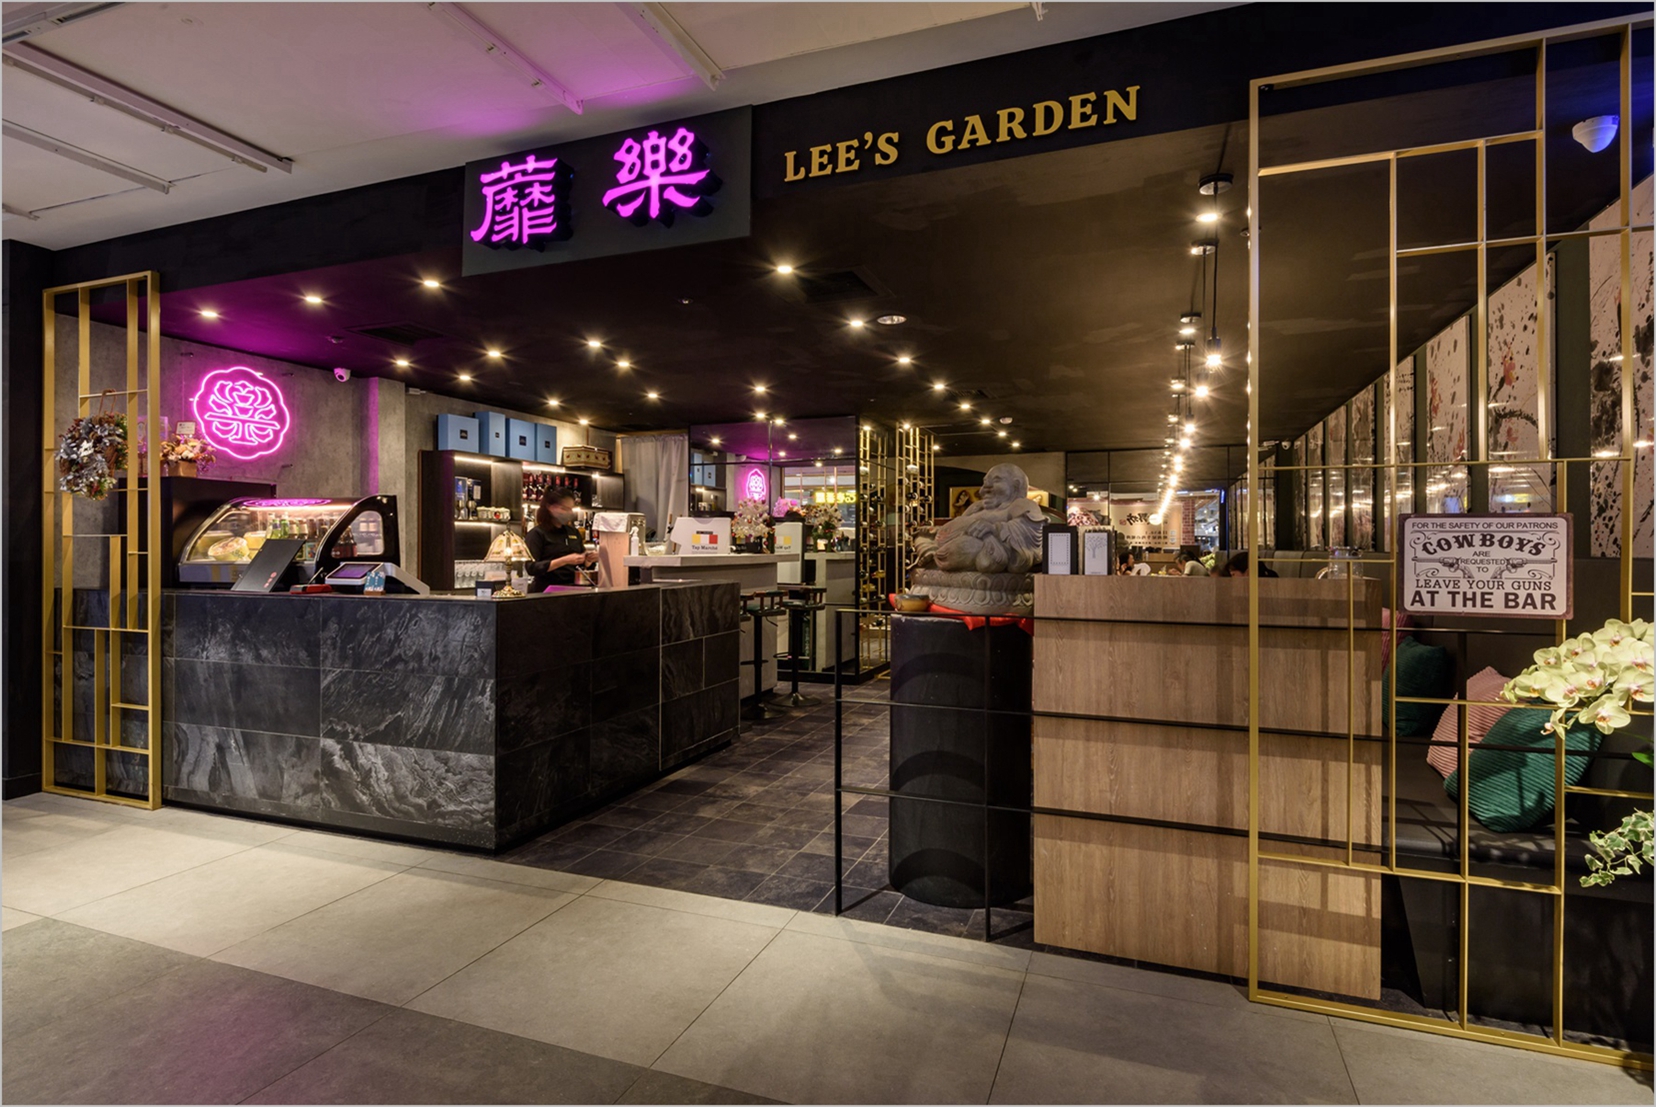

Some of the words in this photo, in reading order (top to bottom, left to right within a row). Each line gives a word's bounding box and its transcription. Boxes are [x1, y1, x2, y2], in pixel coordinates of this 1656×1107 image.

[784, 131, 900, 182] LEE'S
[926, 85, 1140, 154] GARDEN
[1481, 522, 1494, 530] OF
[1495, 522, 1515, 530] OUR
[1516, 522, 1559, 530] PATRONS
[1421, 533, 1546, 556] COWBOYS
[1415, 579, 1461, 589] LEAVE
[1467, 579, 1505, 590] YOUR
[1511, 580, 1552, 591] GUNS
[1410, 590, 1439, 607] AT
[1447, 591, 1494, 608] THE
[1504, 592, 1557, 610] BAR
